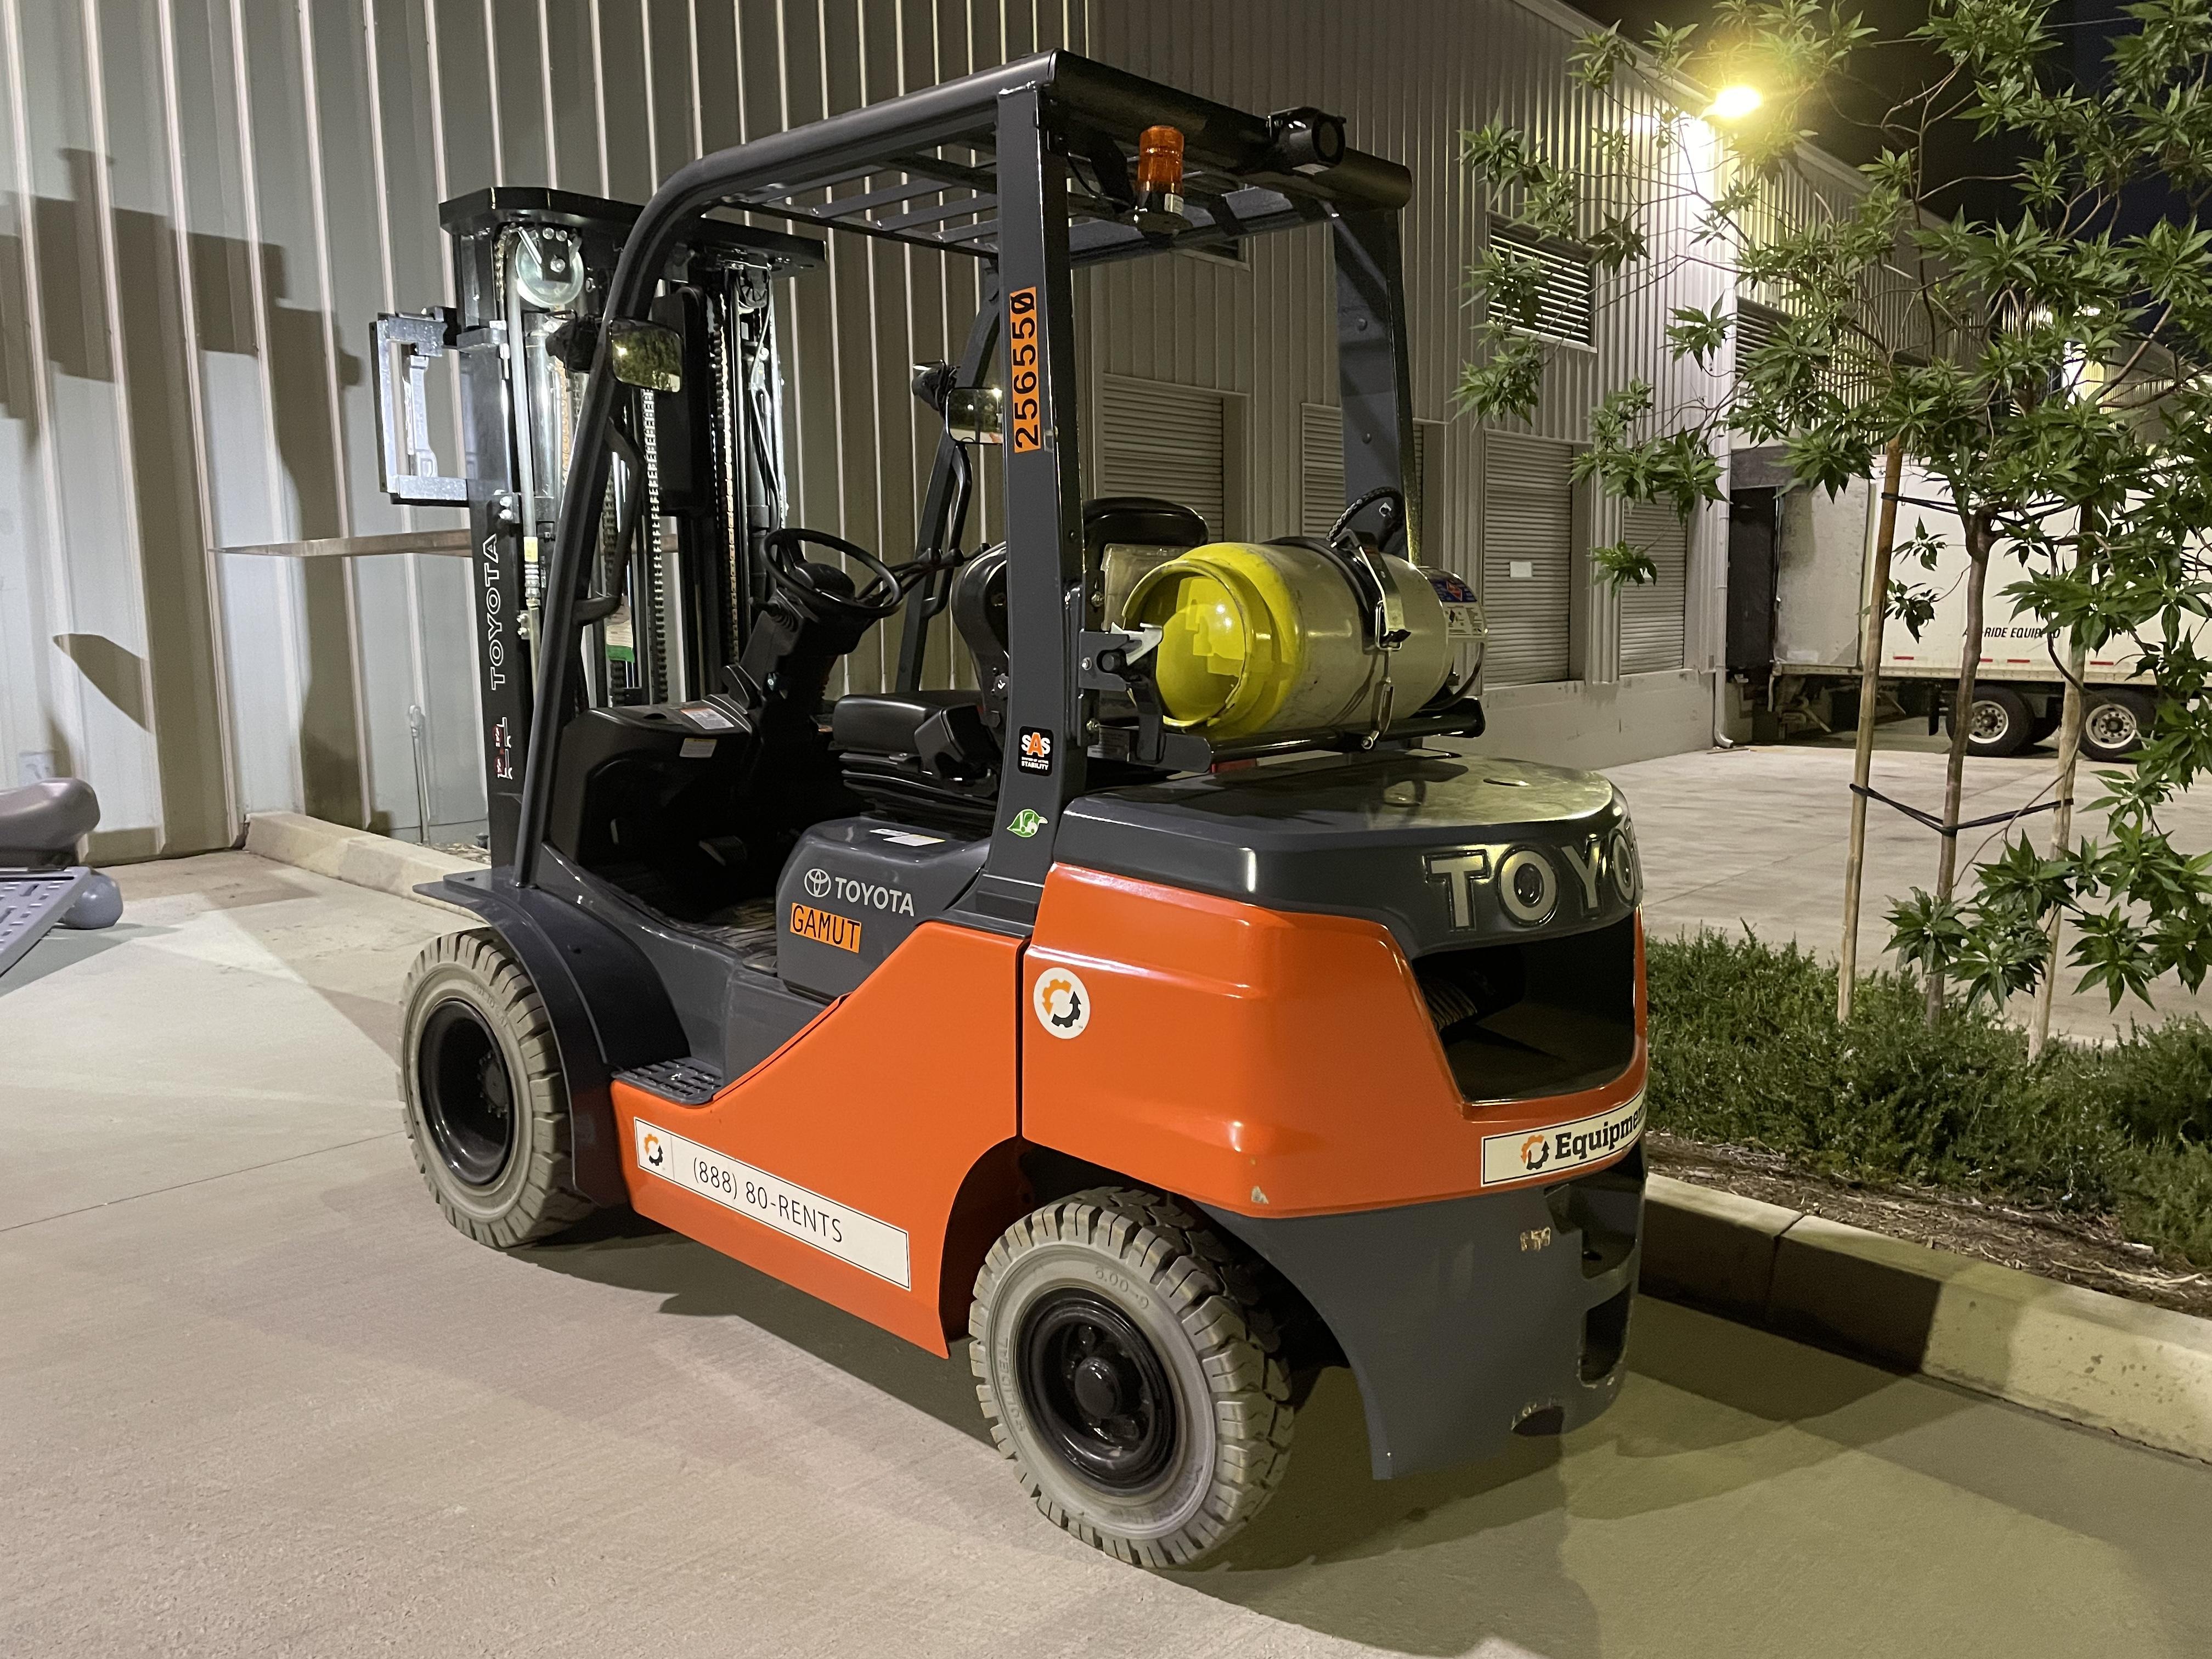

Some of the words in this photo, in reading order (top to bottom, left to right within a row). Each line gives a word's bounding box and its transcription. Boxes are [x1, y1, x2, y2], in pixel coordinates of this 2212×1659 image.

[1011, 292, 1039, 448] 256550
[483, 533, 505, 691] TOYOTA
[1021, 732, 1051, 758] SAS
[1021, 760, 1049, 770] STABILITY
[835, 877, 915, 917] TOYOTA
[792, 905, 860, 949] GAMUT
[693, 1156, 738, 1200] (888)
[746, 1181, 843, 1243] 80-RENTS
